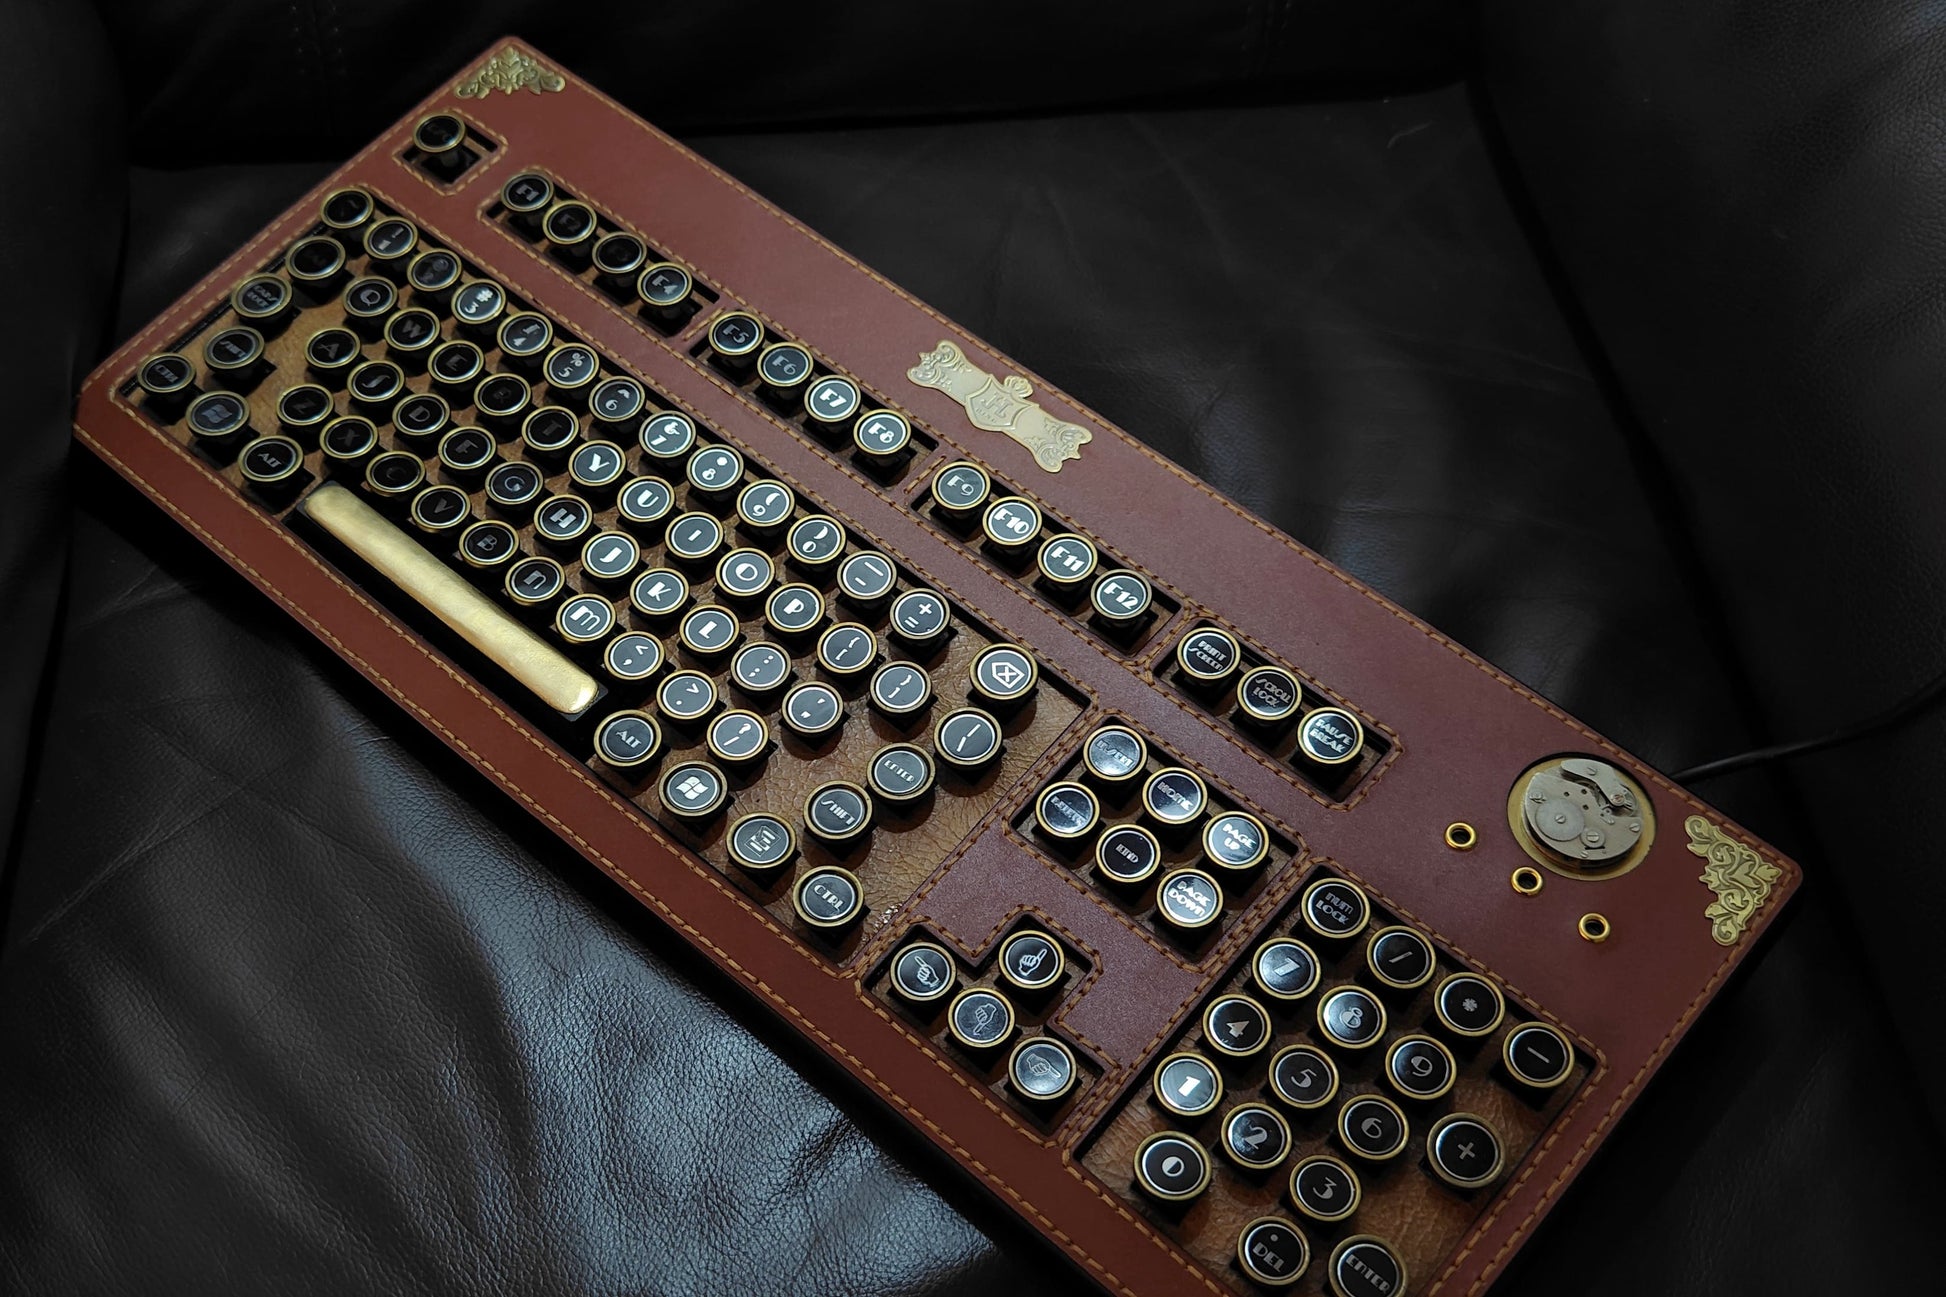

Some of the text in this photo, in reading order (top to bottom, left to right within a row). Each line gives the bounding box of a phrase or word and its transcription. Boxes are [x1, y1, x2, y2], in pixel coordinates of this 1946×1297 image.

[652, 275, 678, 295] F4
[360, 289, 381, 306] Q
[465, 302, 480, 314] 3
[402, 319, 426, 339] W
[722, 323, 749, 344] F5
[319, 343, 340, 360] A
[570, 352, 585, 367] %
[445, 353, 468, 372] E
[558, 367, 573, 378] 5
[772, 354, 797, 376] F6
[605, 399, 618, 411] 6
[819, 387, 847, 408] F7
[408, 406, 430, 422] D
[336, 428, 360, 447] X
[542, 419, 563, 437] T
[867, 422, 895, 444] F8
[456, 439, 479, 454] F
[588, 453, 610, 473] Y
[504, 475, 526, 492] G
[702, 468, 716, 481] 8
[947, 475, 974, 496] F9
[433, 496, 454, 514] V
[637, 489, 659, 508] U
[550, 507, 577, 529] H
[753, 504, 766, 517] 9
[994, 507, 1030, 534] F10
[477, 534, 498, 552] B
[600, 547, 622, 563] J
[1051, 545, 1085, 572] F11
[647, 581, 672, 602] K
[1103, 582, 1139, 610] F12
[783, 598, 805, 614] P
[919, 603, 932, 615] +
[698, 620, 718, 639] L
[904, 616, 919, 628] =
[1253, 687, 1279, 708] LOCK
[1255, 678, 1292, 703] SCROLL
[738, 723, 752, 734] ?
[1315, 719, 1353, 745] PAUSE
[616, 730, 642, 749] ALT
[1309, 728, 1345, 754] BREAK
[820, 799, 855, 826] SHIFT
[1223, 823, 1257, 849] PAGE
[1224, 837, 1241, 851] UP
[813, 884, 846, 912] CTRL
[1168, 888, 1206, 917] DOWN
[1177, 881, 1211, 906] PAGE
[1315, 899, 1350, 925] LOCK
[1339, 1006, 1364, 1029] 8
[1410, 1055, 1433, 1077] 9
[1178, 1075, 1200, 1097] 1
[1290, 1068, 1318, 1088] 5
[1244, 1121, 1268, 1150] 2
[1361, 1117, 1383, 1139] 6
[1457, 1141, 1476, 1160] +
[1313, 1176, 1337, 1201] 3
[1252, 1241, 1285, 1273] DEL
